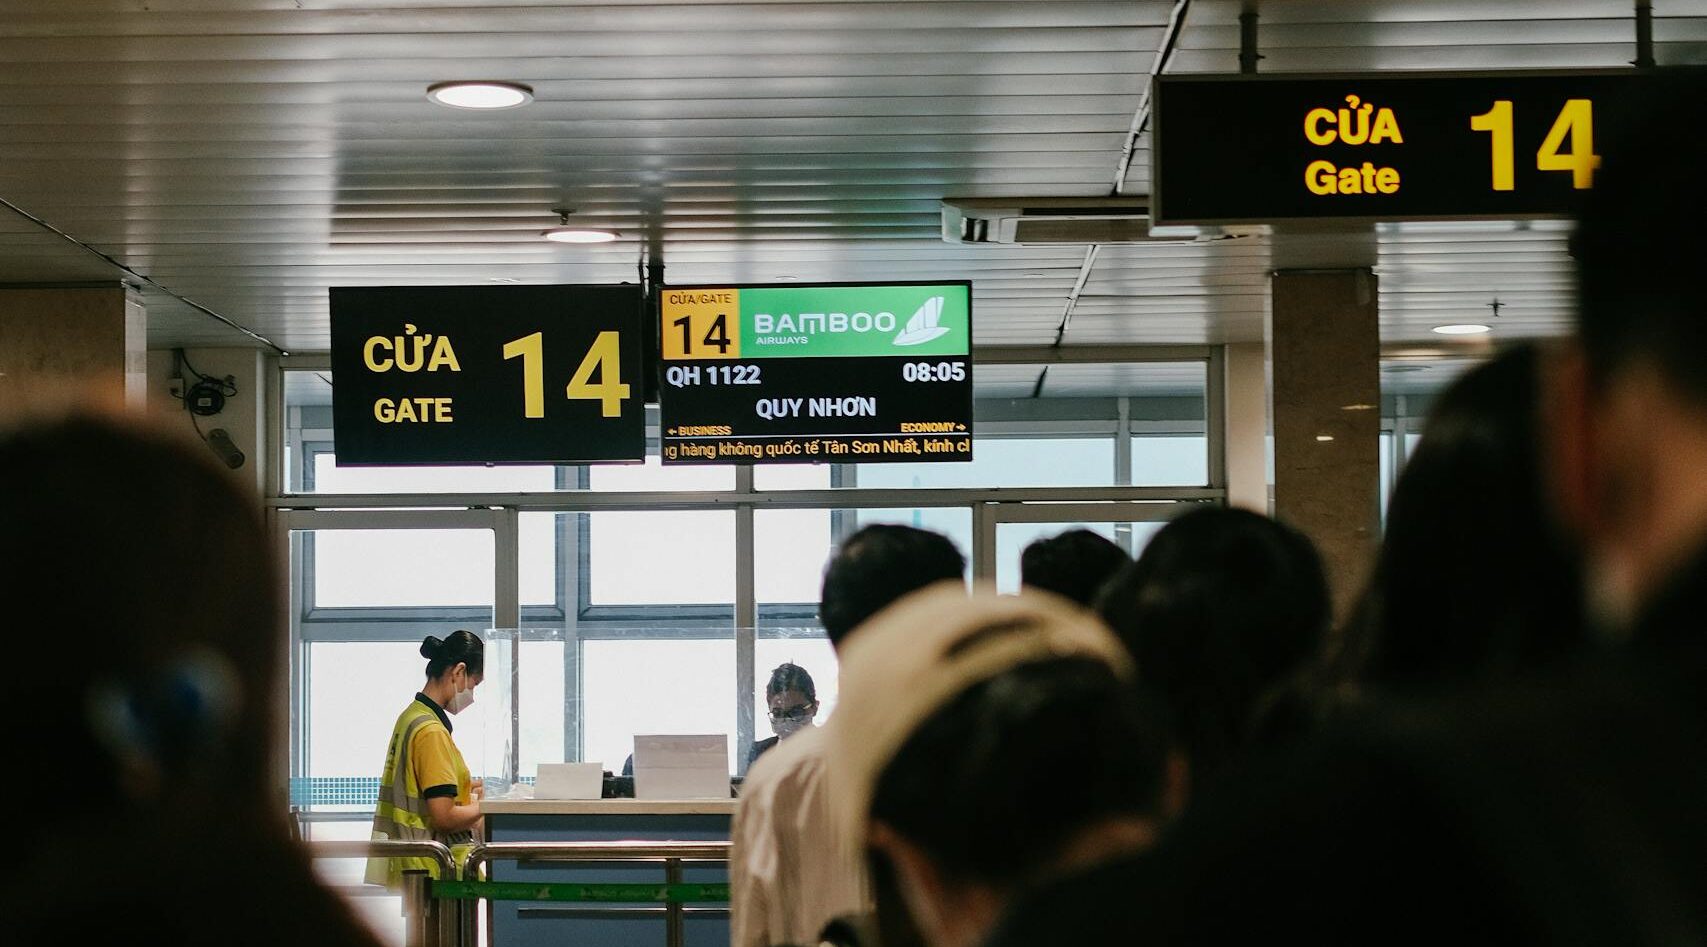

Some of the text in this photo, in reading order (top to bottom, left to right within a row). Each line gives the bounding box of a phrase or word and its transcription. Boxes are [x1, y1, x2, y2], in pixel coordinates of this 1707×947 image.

[1304, 94, 1404, 146] CỬA
[1470, 98, 1602, 191] 14
[1304, 160, 1401, 195] Gate
[673, 314, 731, 354] 14
[754, 311, 896, 335] BAMBOO
[363, 323, 461, 373] CỬA
[755, 336, 809, 345] AIRWAYS
[502, 330, 631, 419] 14
[666, 364, 762, 387] QH 1122
[902, 362, 966, 383] 08:05
[373, 397, 453, 424] GATE
[755, 395, 876, 421] QUY NHƠN
[678, 425, 733, 436] BUSINESS
[900, 422, 956, 433] ECONOMY
[679, 442, 717, 460] hàng
[719, 441, 763, 459] không
[804, 439, 819, 455] tế
[822, 440, 848, 455] Tân
[852, 439, 879, 454] Sơn
[923, 438, 955, 453] kính
